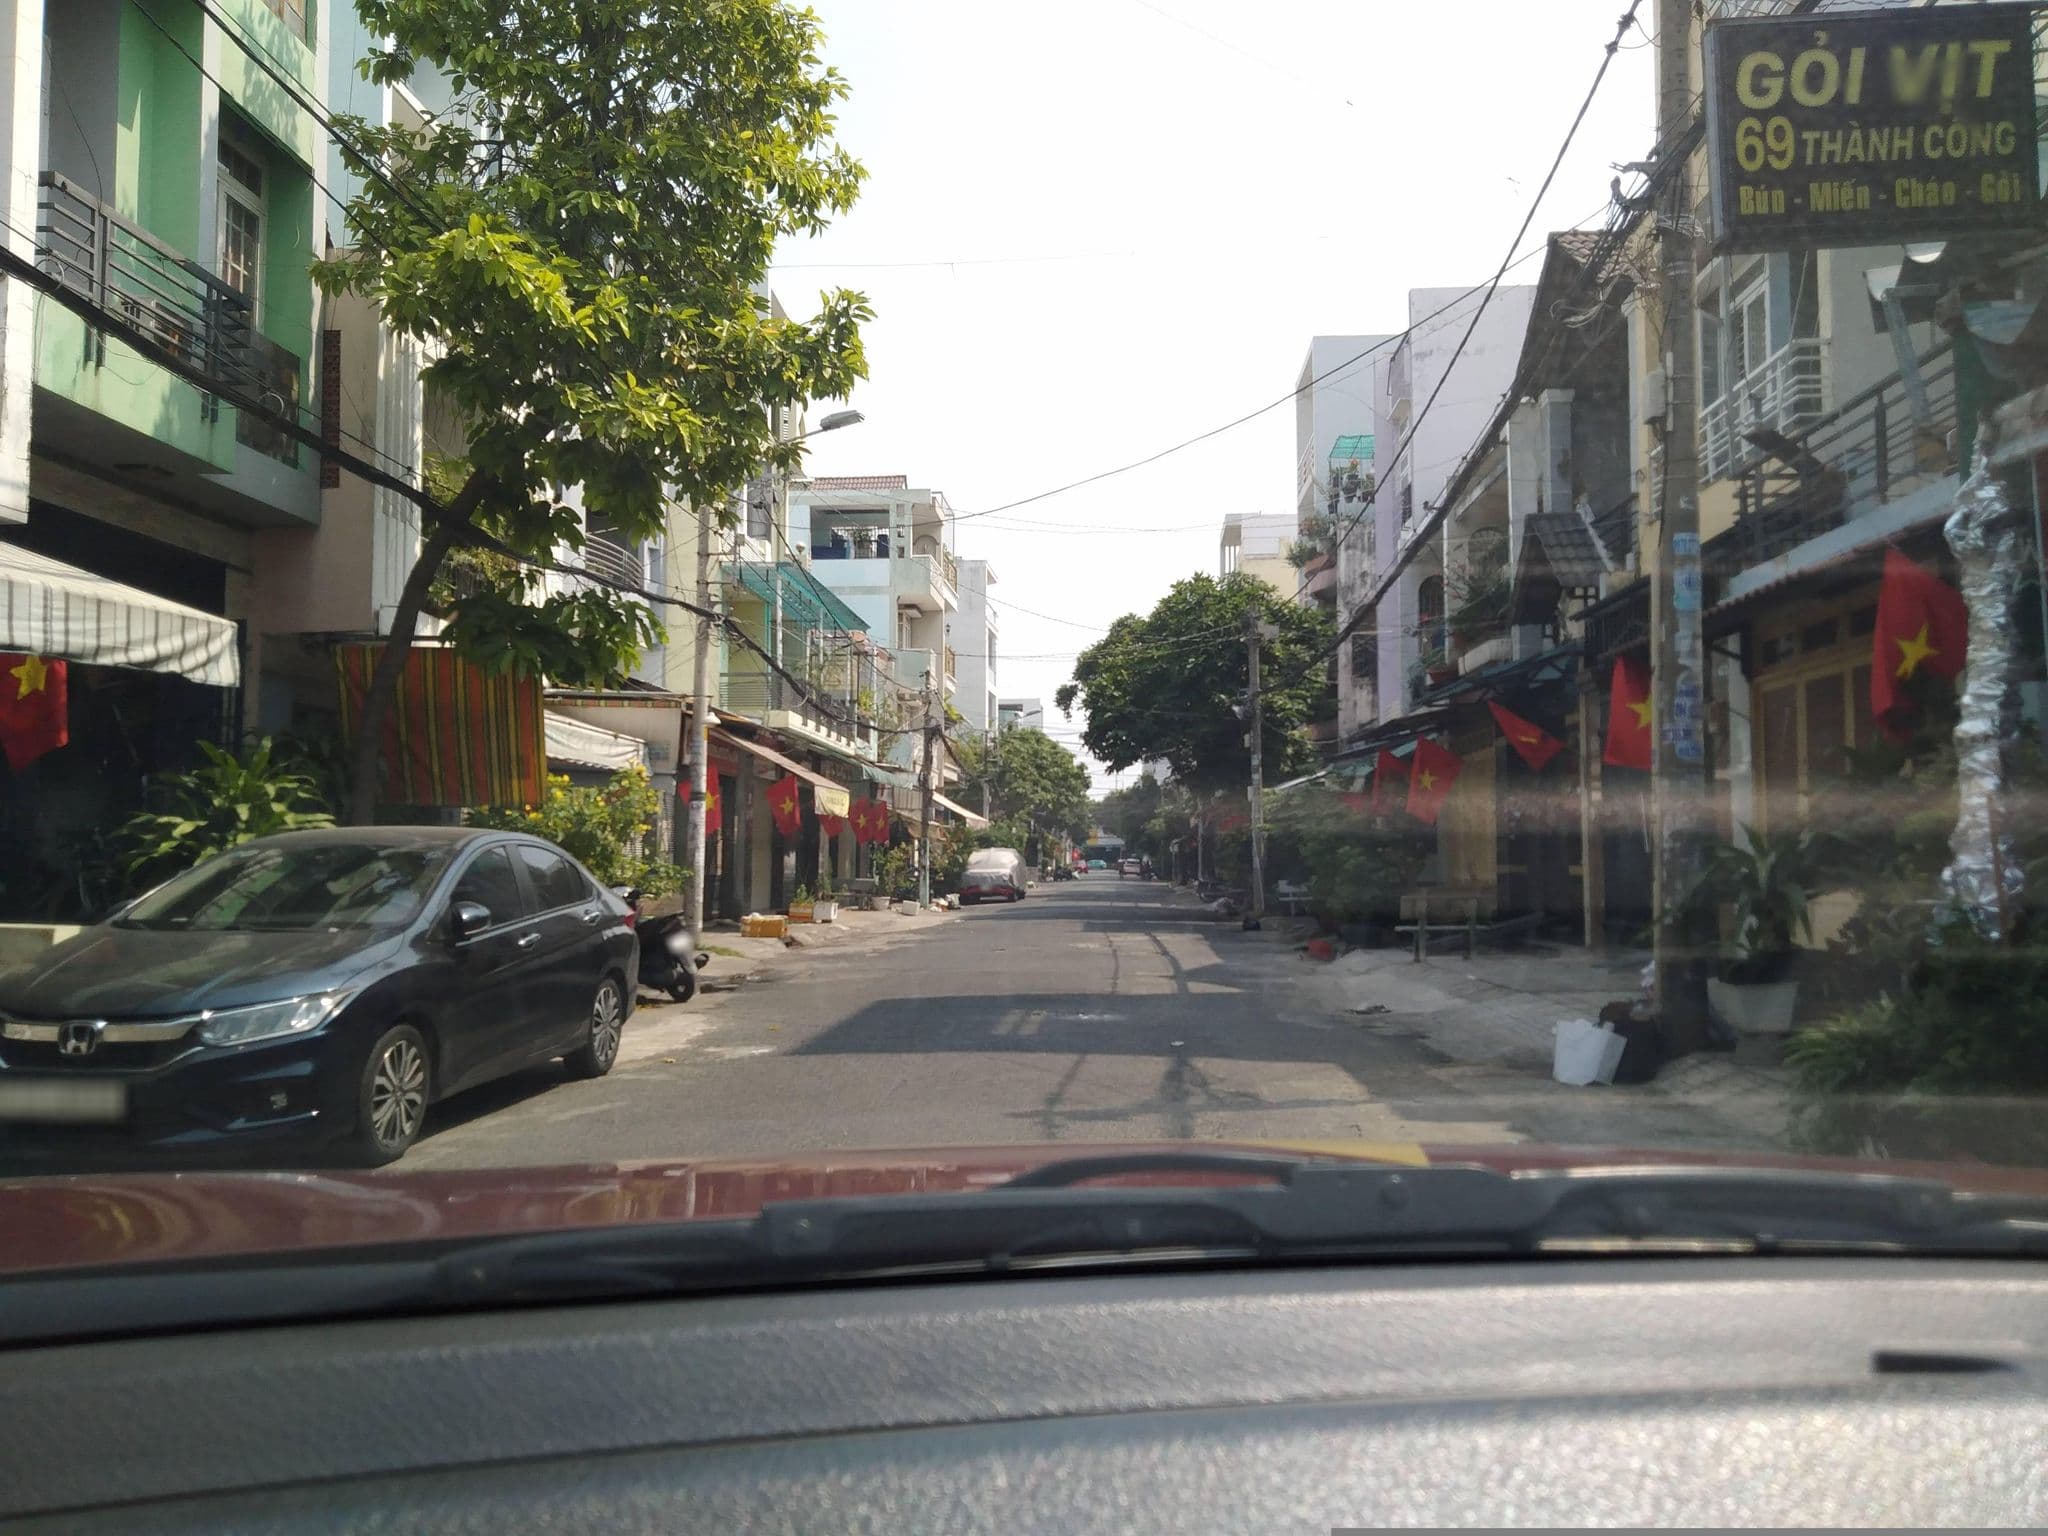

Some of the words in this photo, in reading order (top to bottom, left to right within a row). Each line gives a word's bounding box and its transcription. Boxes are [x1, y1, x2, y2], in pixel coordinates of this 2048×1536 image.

[1736, 31, 1866, 109] GỎI
[1888, 40, 2012, 115] VỊT
[1735, 116, 1795, 171] 69
[1801, 121, 1914, 165] THÀNH
[1923, 117, 2016, 159] CÔNG
[1739, 184, 1785, 215] Bún
[1809, 178, 1871, 212] Miến
[1895, 175, 1956, 208] Cháo
